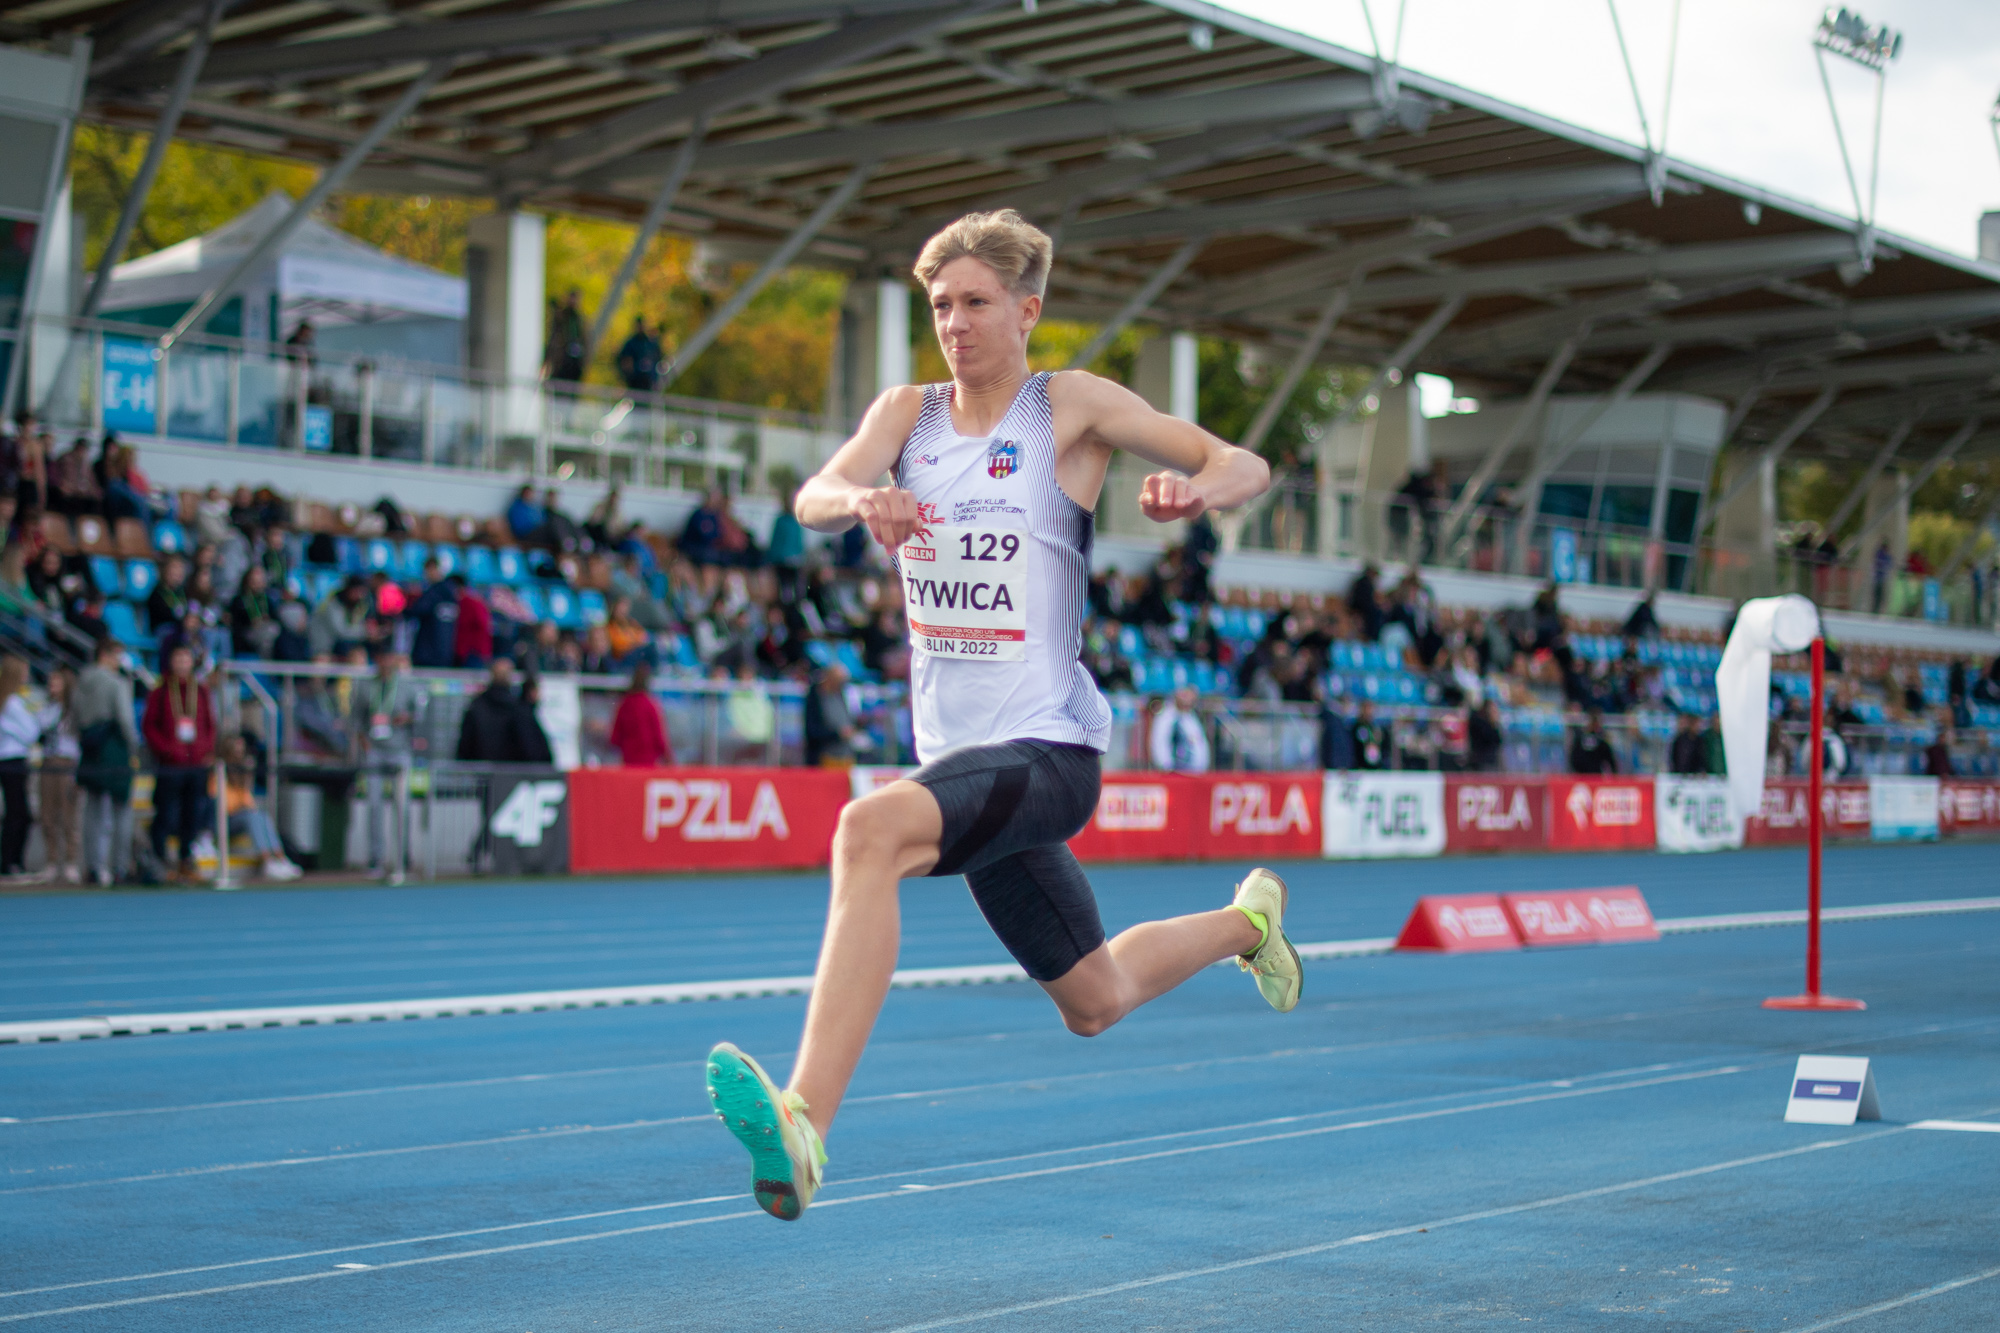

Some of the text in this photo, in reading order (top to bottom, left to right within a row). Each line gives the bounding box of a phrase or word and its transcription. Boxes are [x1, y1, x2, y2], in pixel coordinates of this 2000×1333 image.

[917, 502, 945, 524] KL
[905, 547, 934, 560] ORLEN
[959, 532, 1020, 562] 129
[906, 569, 1014, 611] ŻYWICA
[959, 640, 998, 655] 2022
[490, 780, 567, 847] 4F
[643, 778, 790, 842] PZLA
[1210, 782, 1313, 837] PZLA
[1361, 792, 1428, 840] FUEL
[1457, 785, 1533, 832] PZLA
